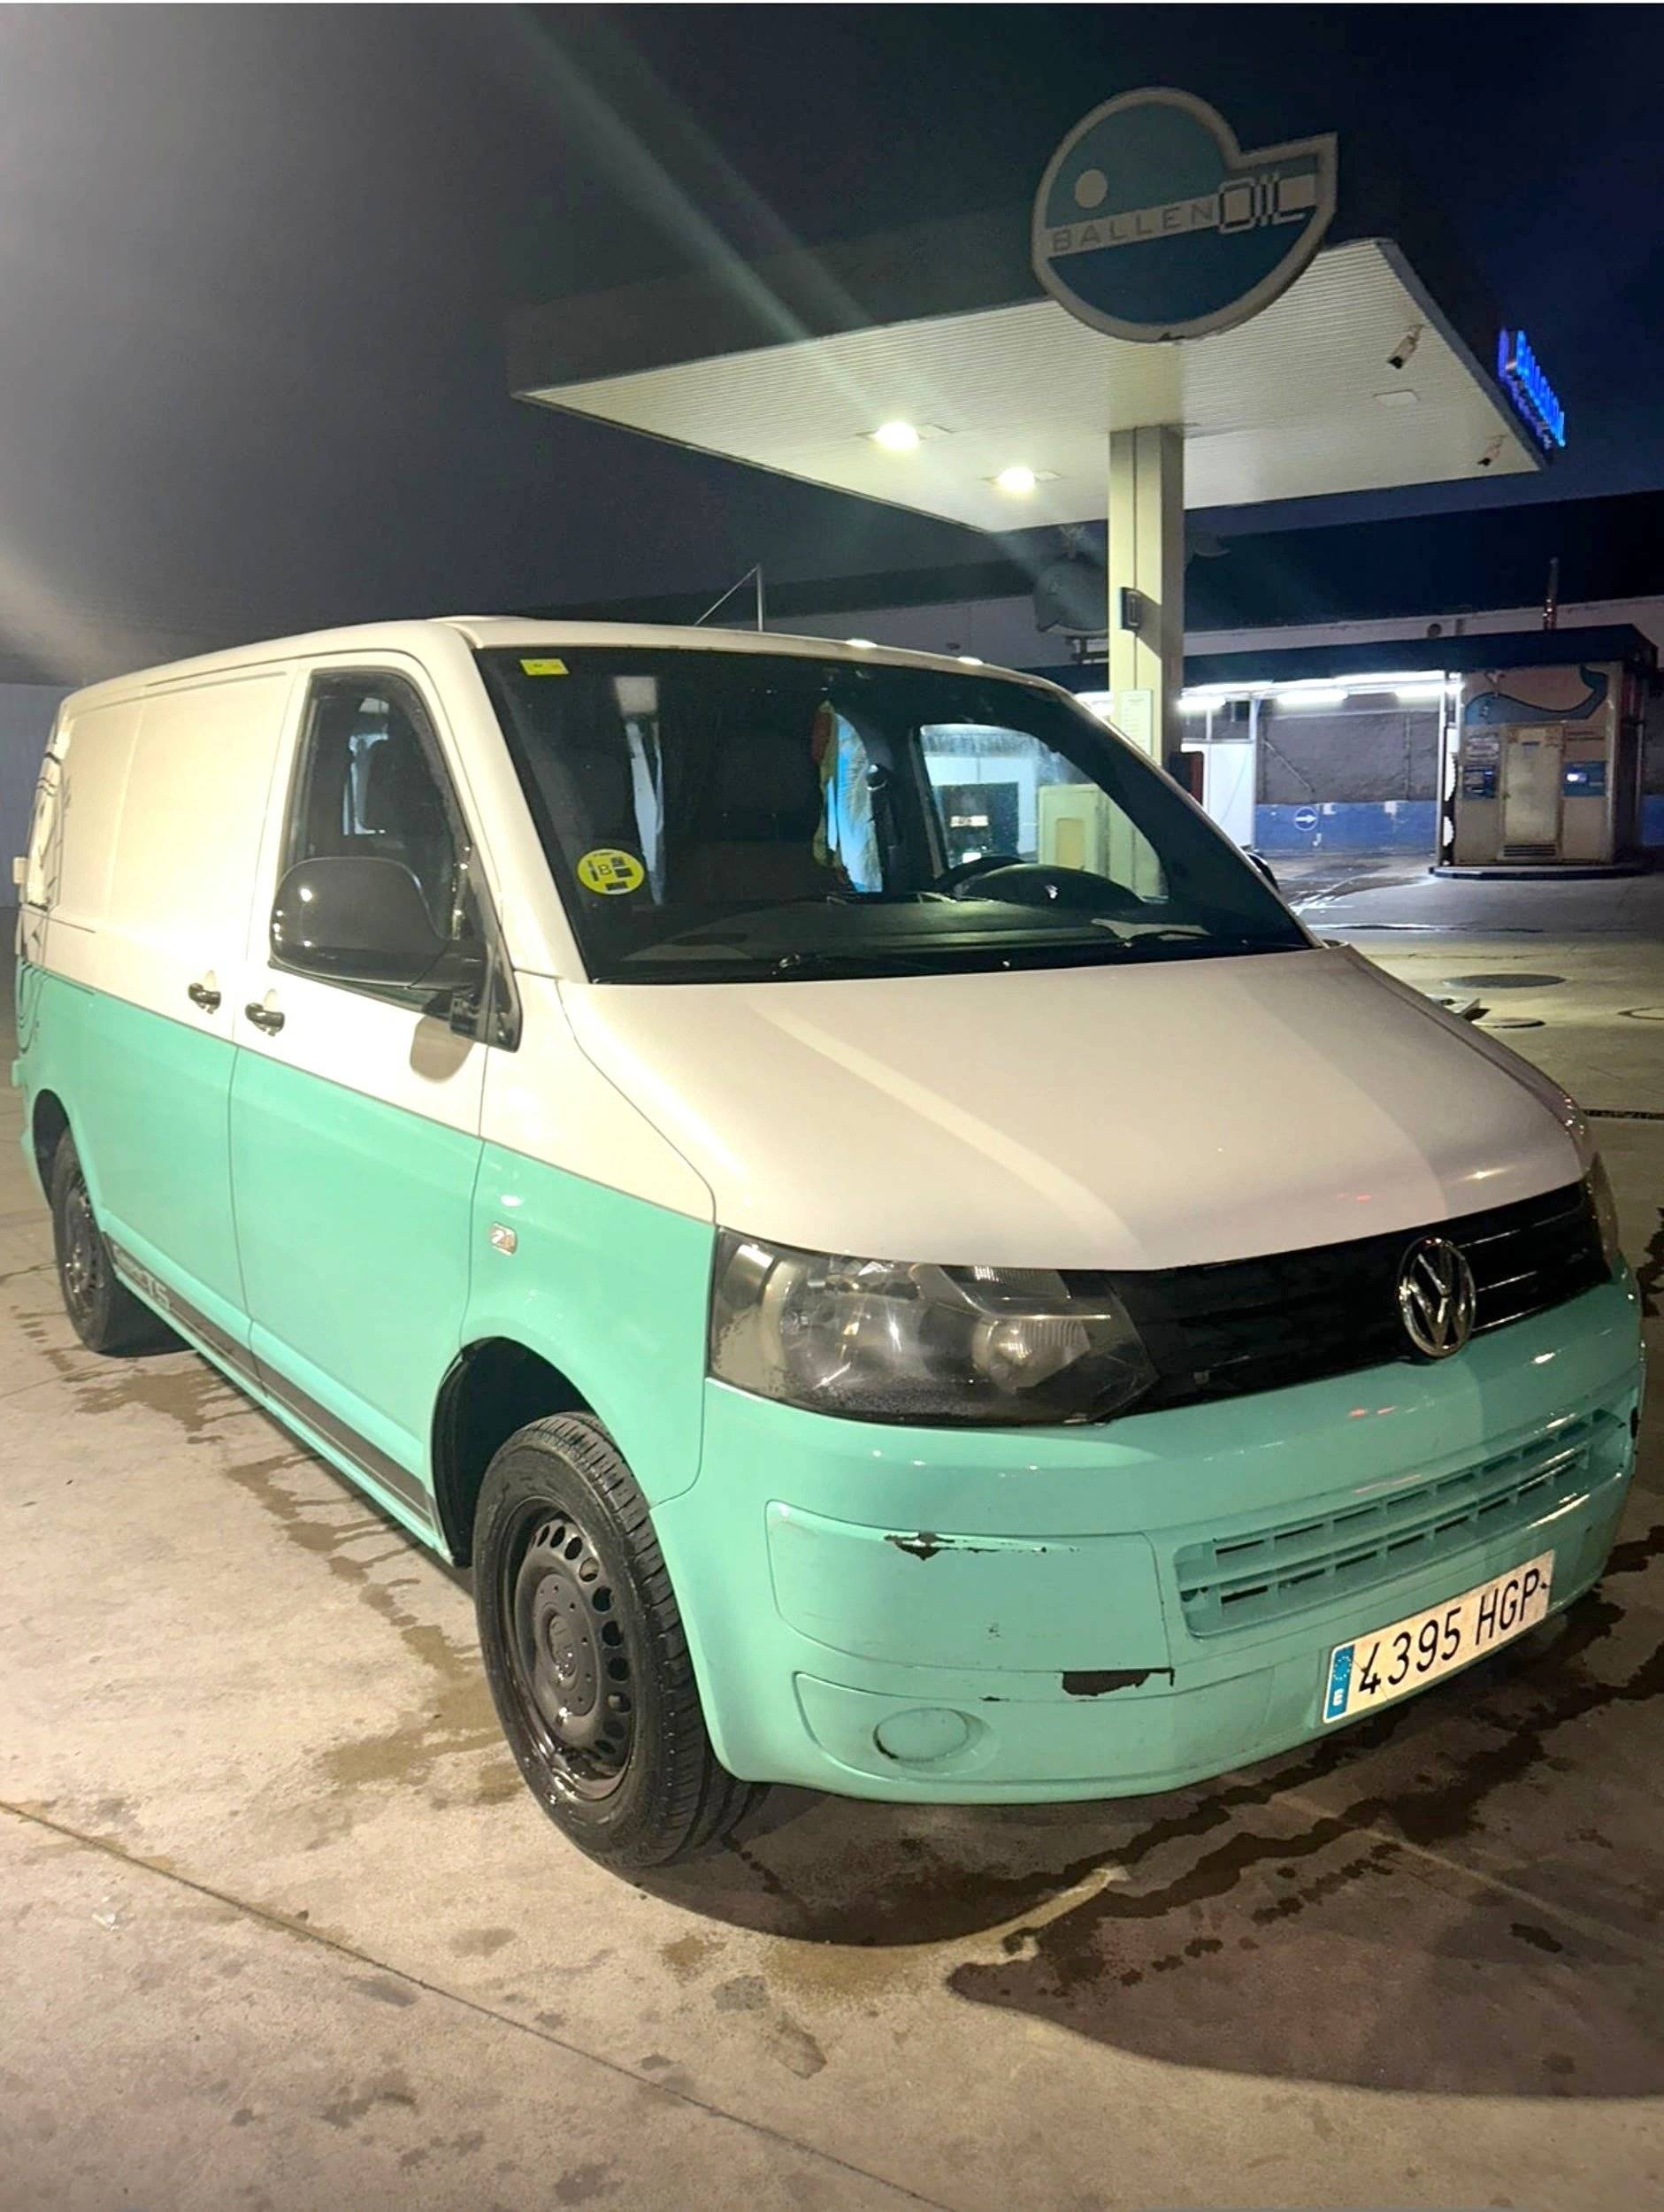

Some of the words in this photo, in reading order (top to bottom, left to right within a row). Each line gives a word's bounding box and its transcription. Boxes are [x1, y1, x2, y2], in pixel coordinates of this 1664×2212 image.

[1359, 1606, 1461, 1695] 4395
[1475, 1567, 1540, 1646] HGP
[1332, 1688, 1345, 1707] E
